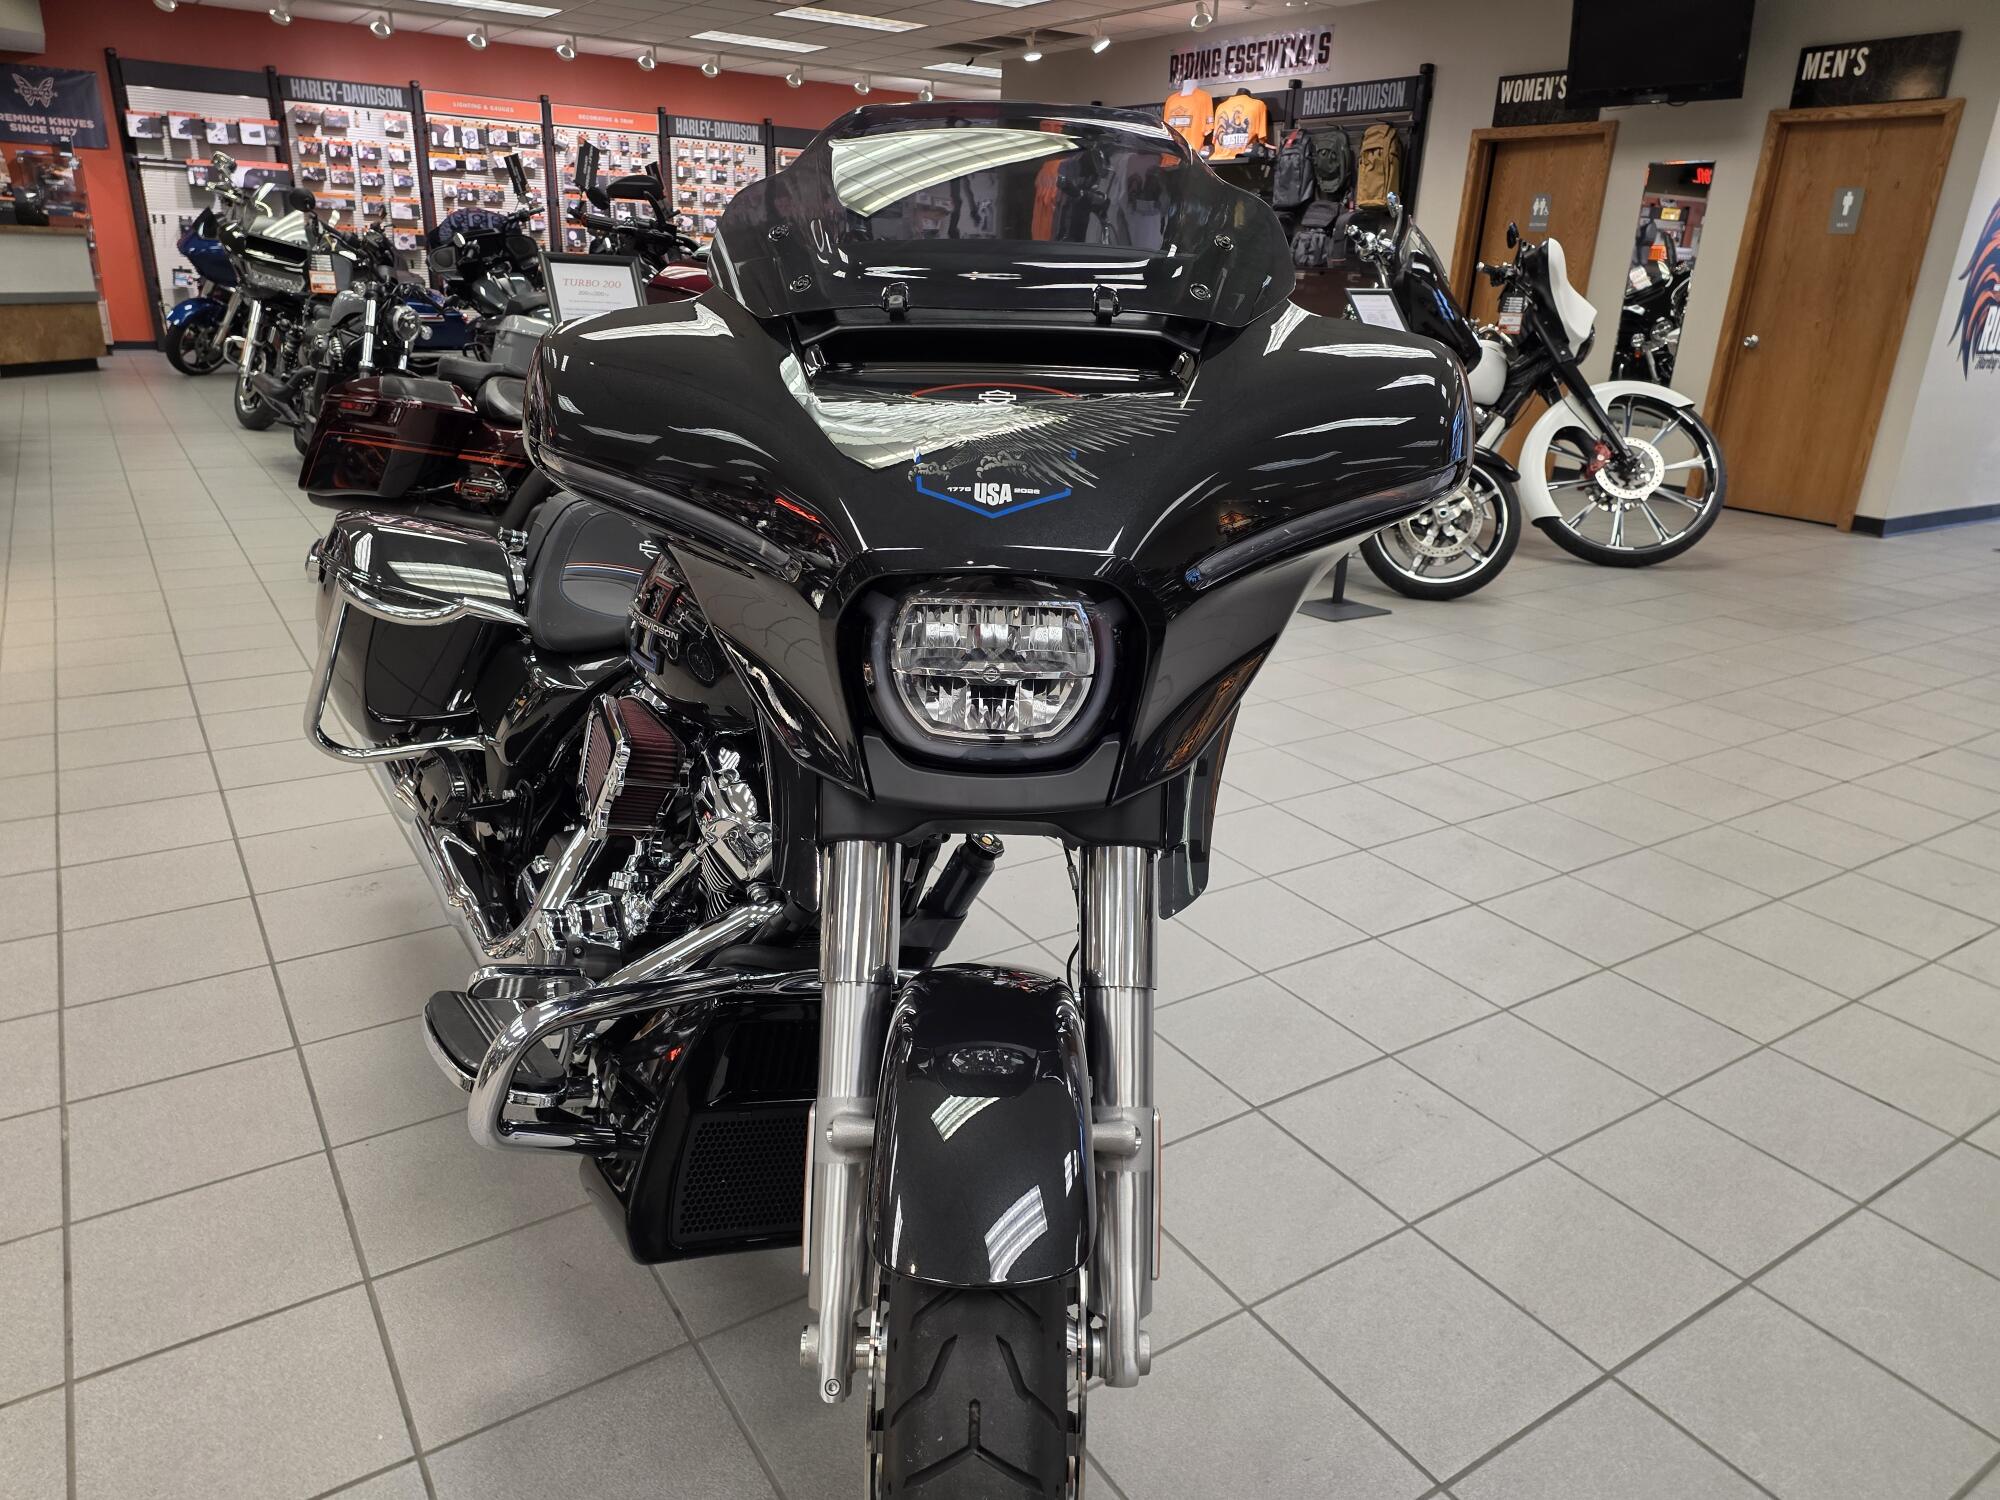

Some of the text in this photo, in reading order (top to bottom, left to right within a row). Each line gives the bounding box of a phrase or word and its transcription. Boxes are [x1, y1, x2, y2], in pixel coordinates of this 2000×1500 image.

[1169, 32, 1332, 84] RIDING ESSENTIALS
[1801, 47, 1870, 81] MEN'S
[290, 78, 403, 108] HARLEY-DAVIDSON
[1302, 81, 1406, 116] HARLEY-DAVIDSON
[1500, 75, 1568, 104] WOMEN'S
[0, 112, 95, 129] REMIUM KNIVES
[9, 123, 48, 135] SINCE
[675, 117, 759, 142] HARLEY-DAVIDSON
[563, 278, 622, 289] TURBO 200
[973, 482, 1013, 506] USA
